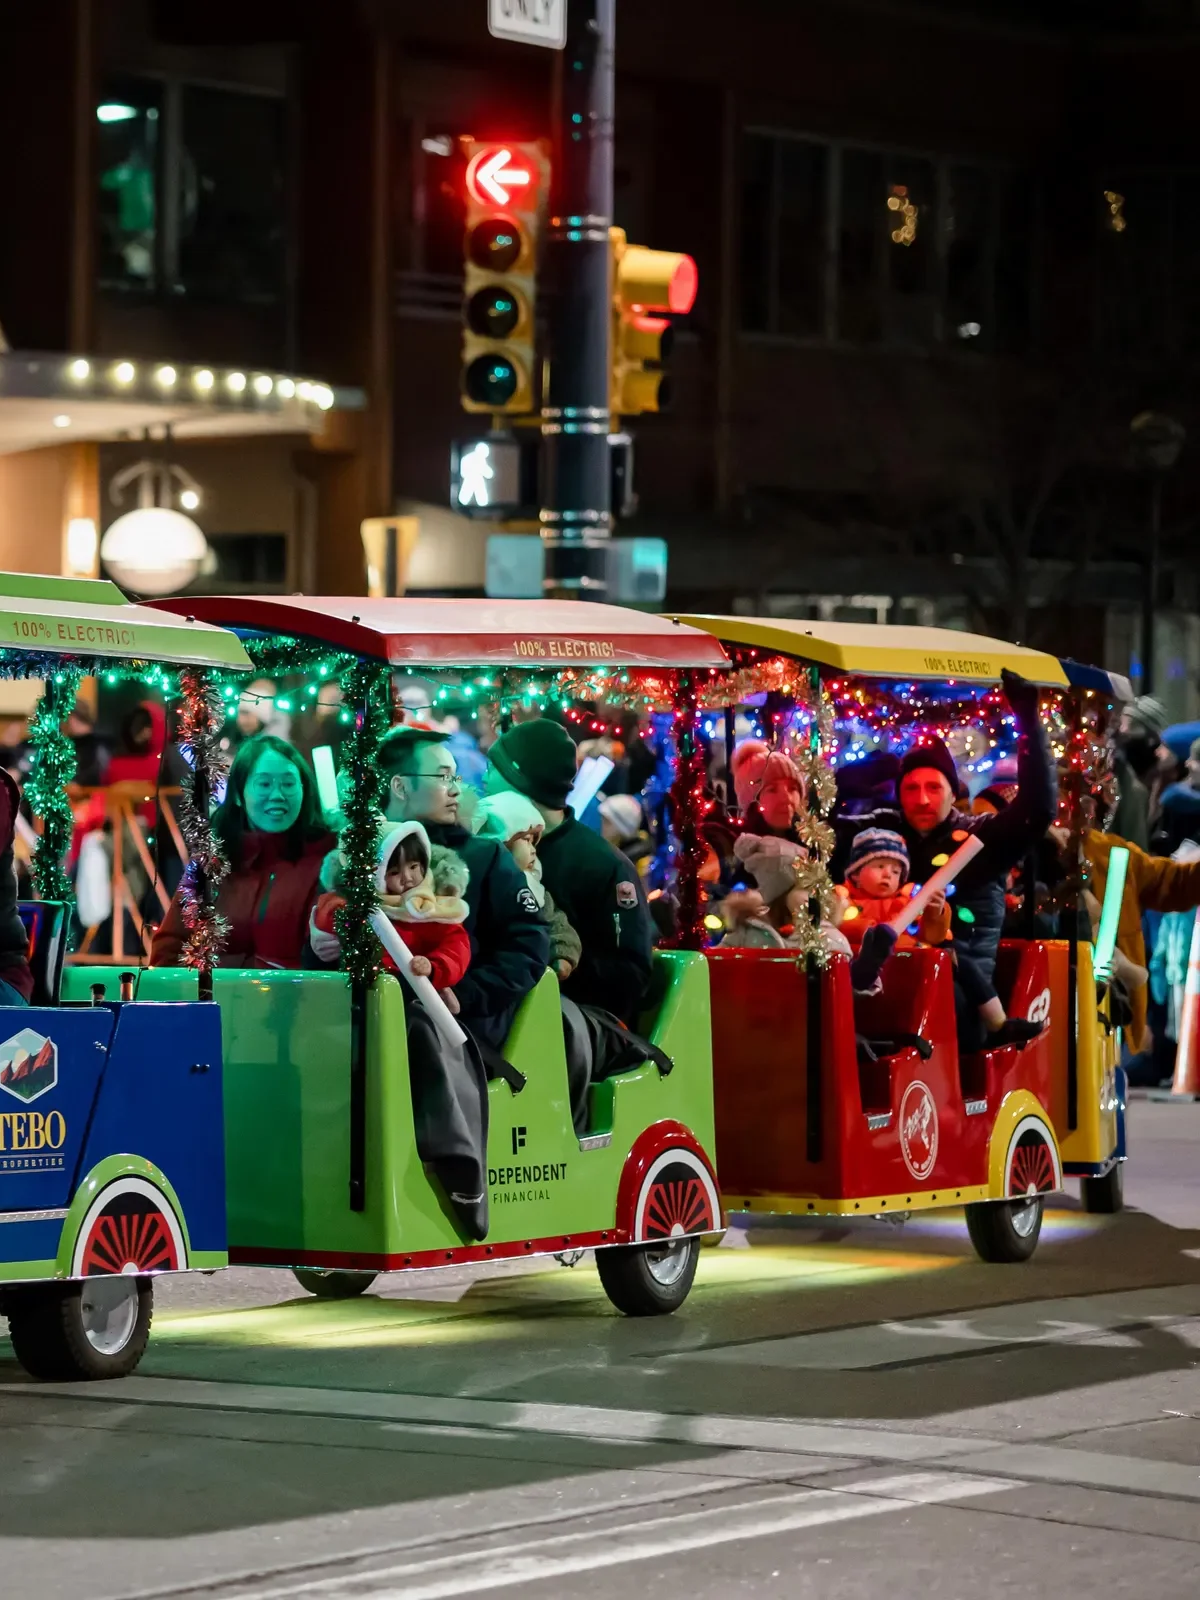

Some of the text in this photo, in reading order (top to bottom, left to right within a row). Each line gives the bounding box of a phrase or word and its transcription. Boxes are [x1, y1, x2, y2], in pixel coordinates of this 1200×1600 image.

[13, 620, 136, 646] 100% ELECTRIC!
[513, 640, 615, 657] 100% ELECTRIC!
[924, 657, 992, 675] 100% ELECTRIC!
[488, 1163, 567, 1186] DEPENDENT
[493, 1189, 550, 1204] FINANCIAL
